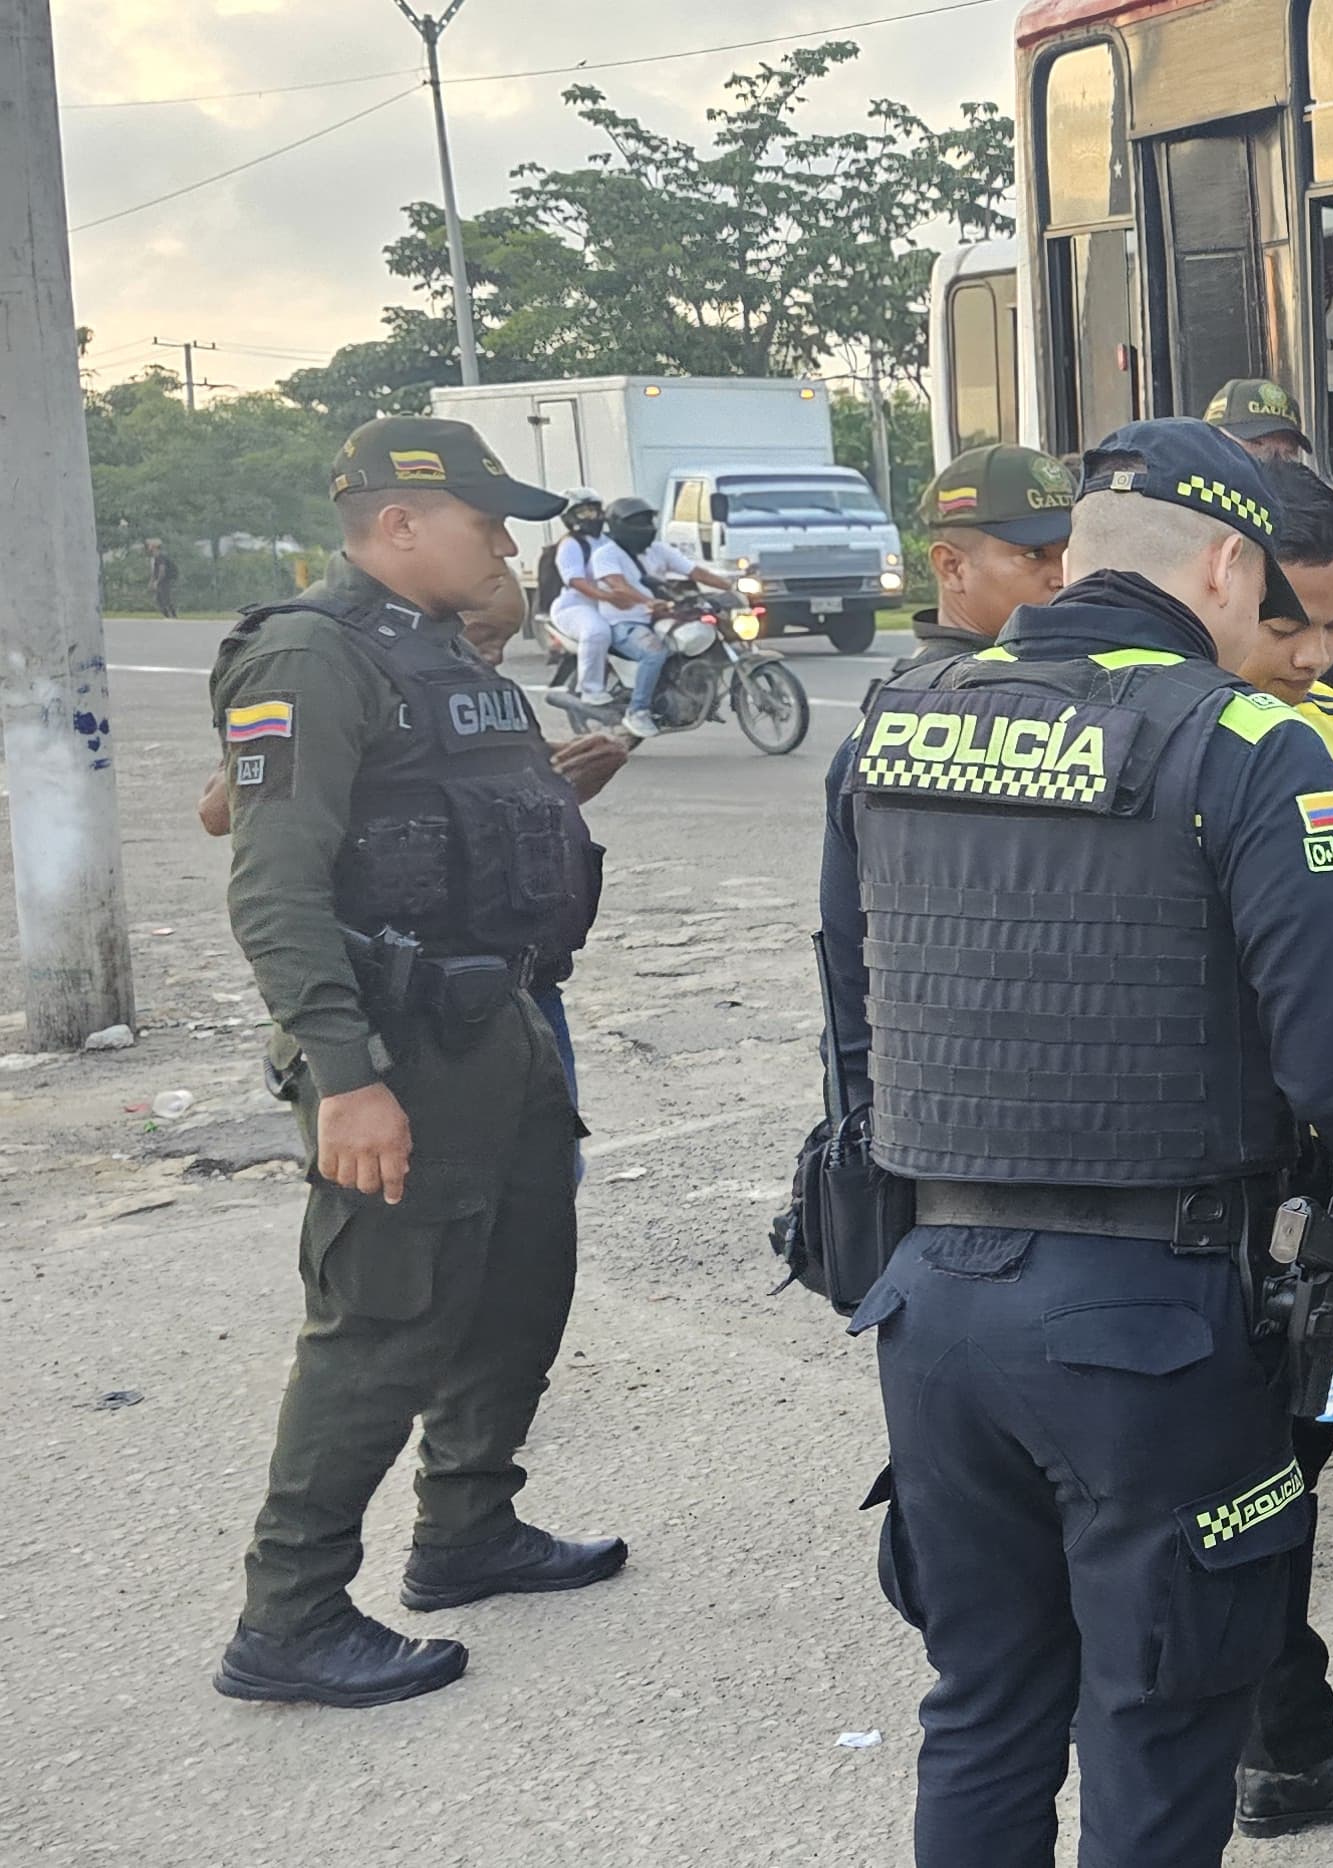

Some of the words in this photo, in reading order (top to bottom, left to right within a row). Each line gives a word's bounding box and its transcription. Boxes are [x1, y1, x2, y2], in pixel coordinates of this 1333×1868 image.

[866, 705, 1104, 775] POLICÍA
[241, 762, 260, 778] A+
[1244, 1472, 1302, 1522] POLICÍA
